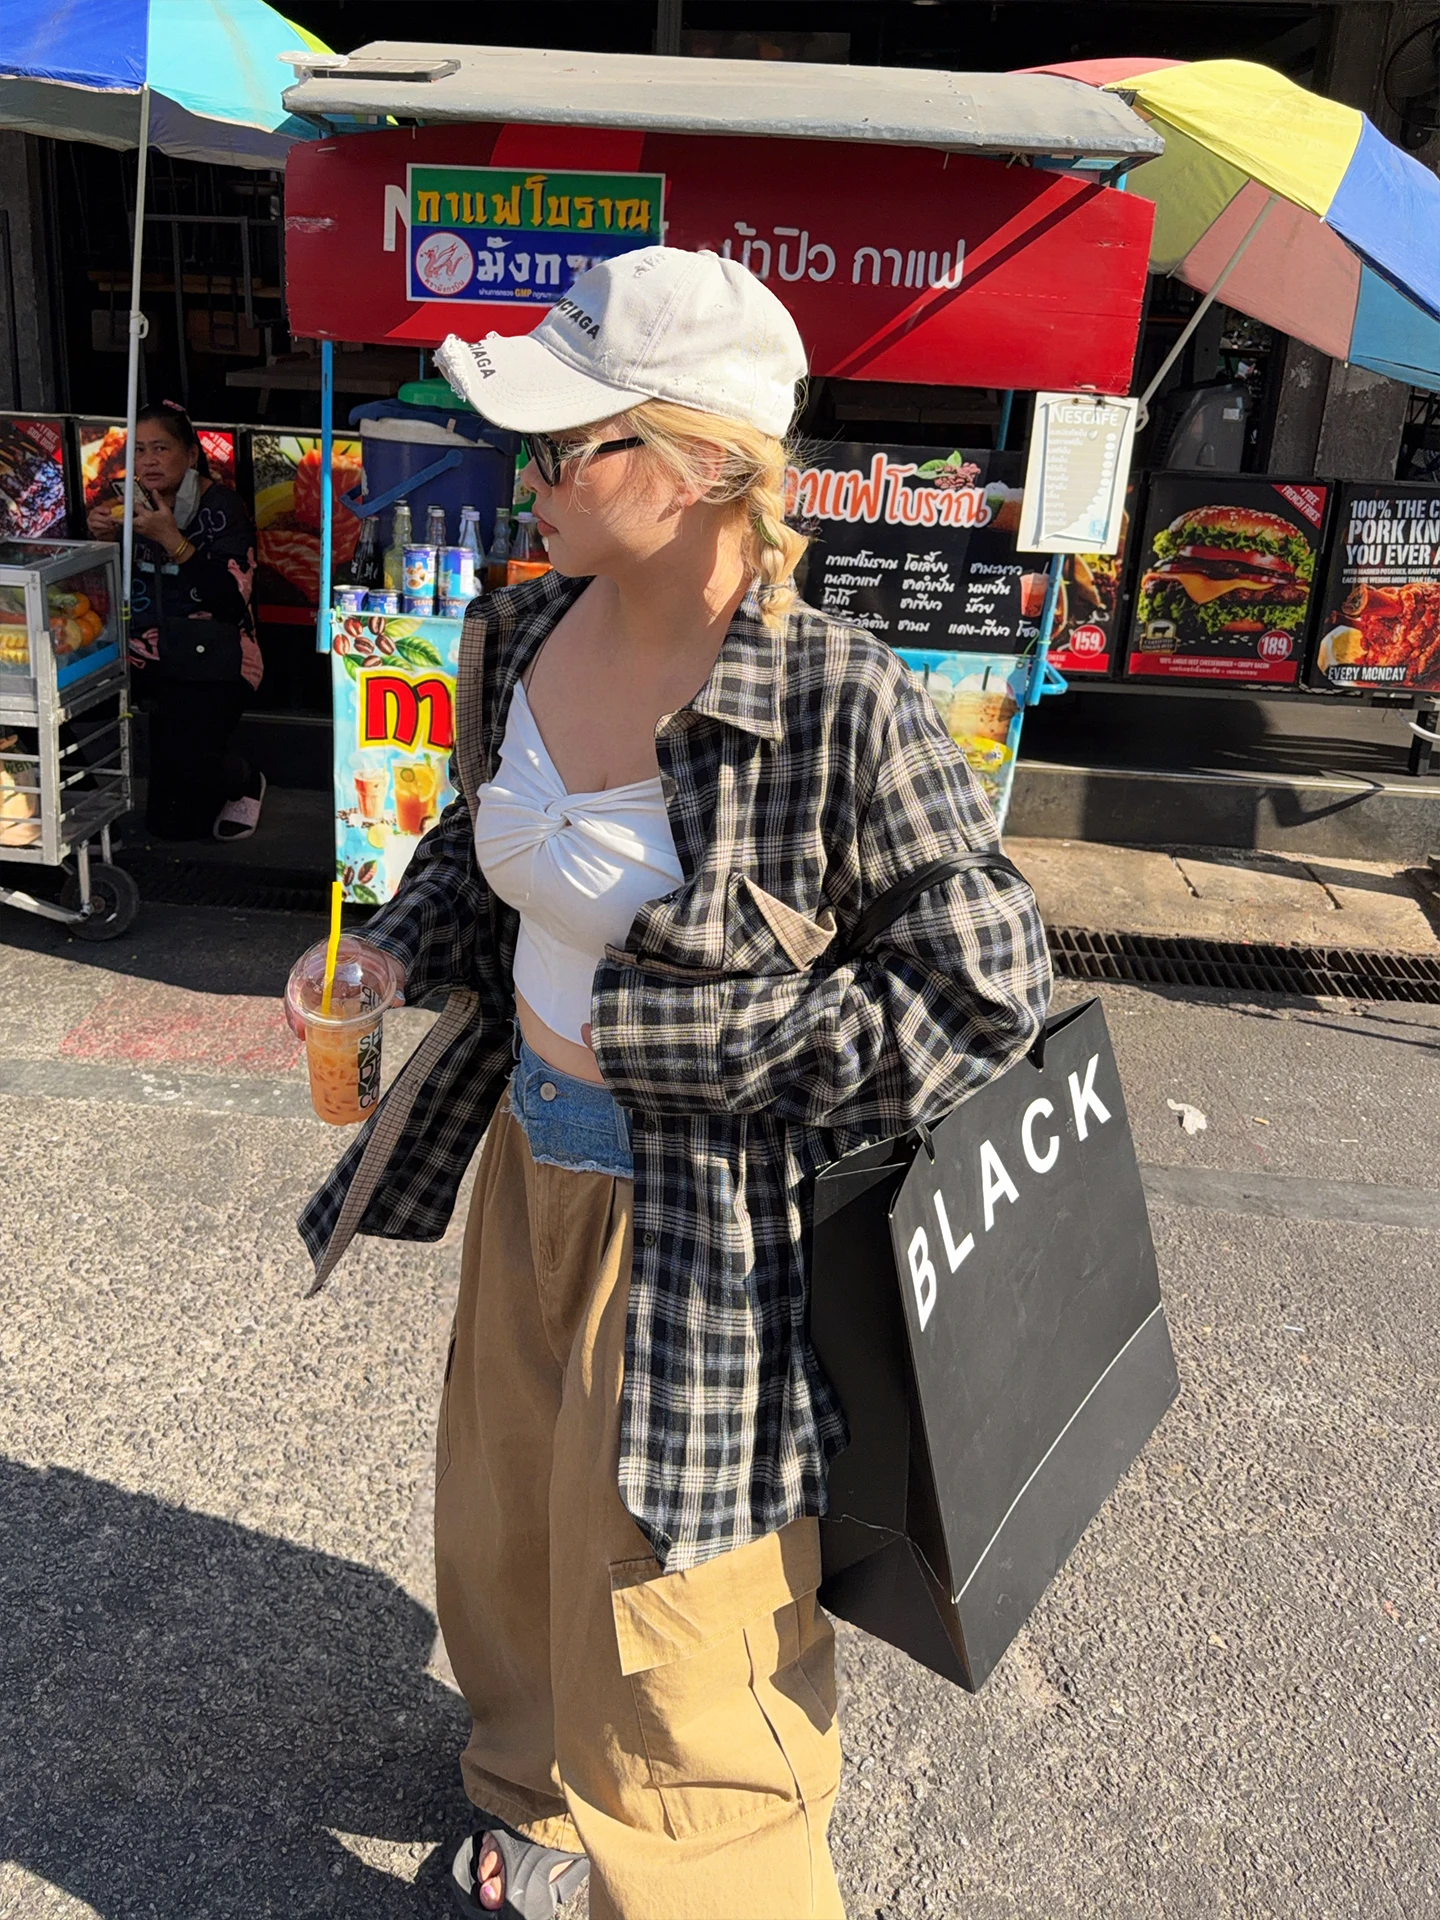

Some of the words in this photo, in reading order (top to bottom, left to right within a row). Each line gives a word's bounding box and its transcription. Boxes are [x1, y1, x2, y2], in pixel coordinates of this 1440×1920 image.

[417, 174, 652, 231] กาแฟโบราณ
[852, 239, 965, 289] กาแฟ
[515, 288, 532, 297] GMP
[43, 427, 60, 443] FREE
[215, 437, 233, 454] FREE
[1281, 485, 1306, 508] FRENCH
[1301, 503, 1321, 522] FRIES
[1350, 500, 1391, 519] 100%
[1395, 500, 1427, 518] THE
[1348, 519, 1406, 544] PORK
[1346, 544, 1382, 565] YOU
[1384, 544, 1431, 565] EVER
[824, 574, 882, 587] เนสกาแฟ
[967, 577, 1011, 596] นมเย็น
[900, 593, 943, 611] ชาเขียว
[897, 619, 930, 633] ชานม
[1074, 631, 1100, 651] 159
[1261, 636, 1288, 656] 189
[1328, 667, 1360, 681] EVERY
[1362, 667, 1406, 681] MONDAY
[908, 1053, 1112, 1332] BLACK
